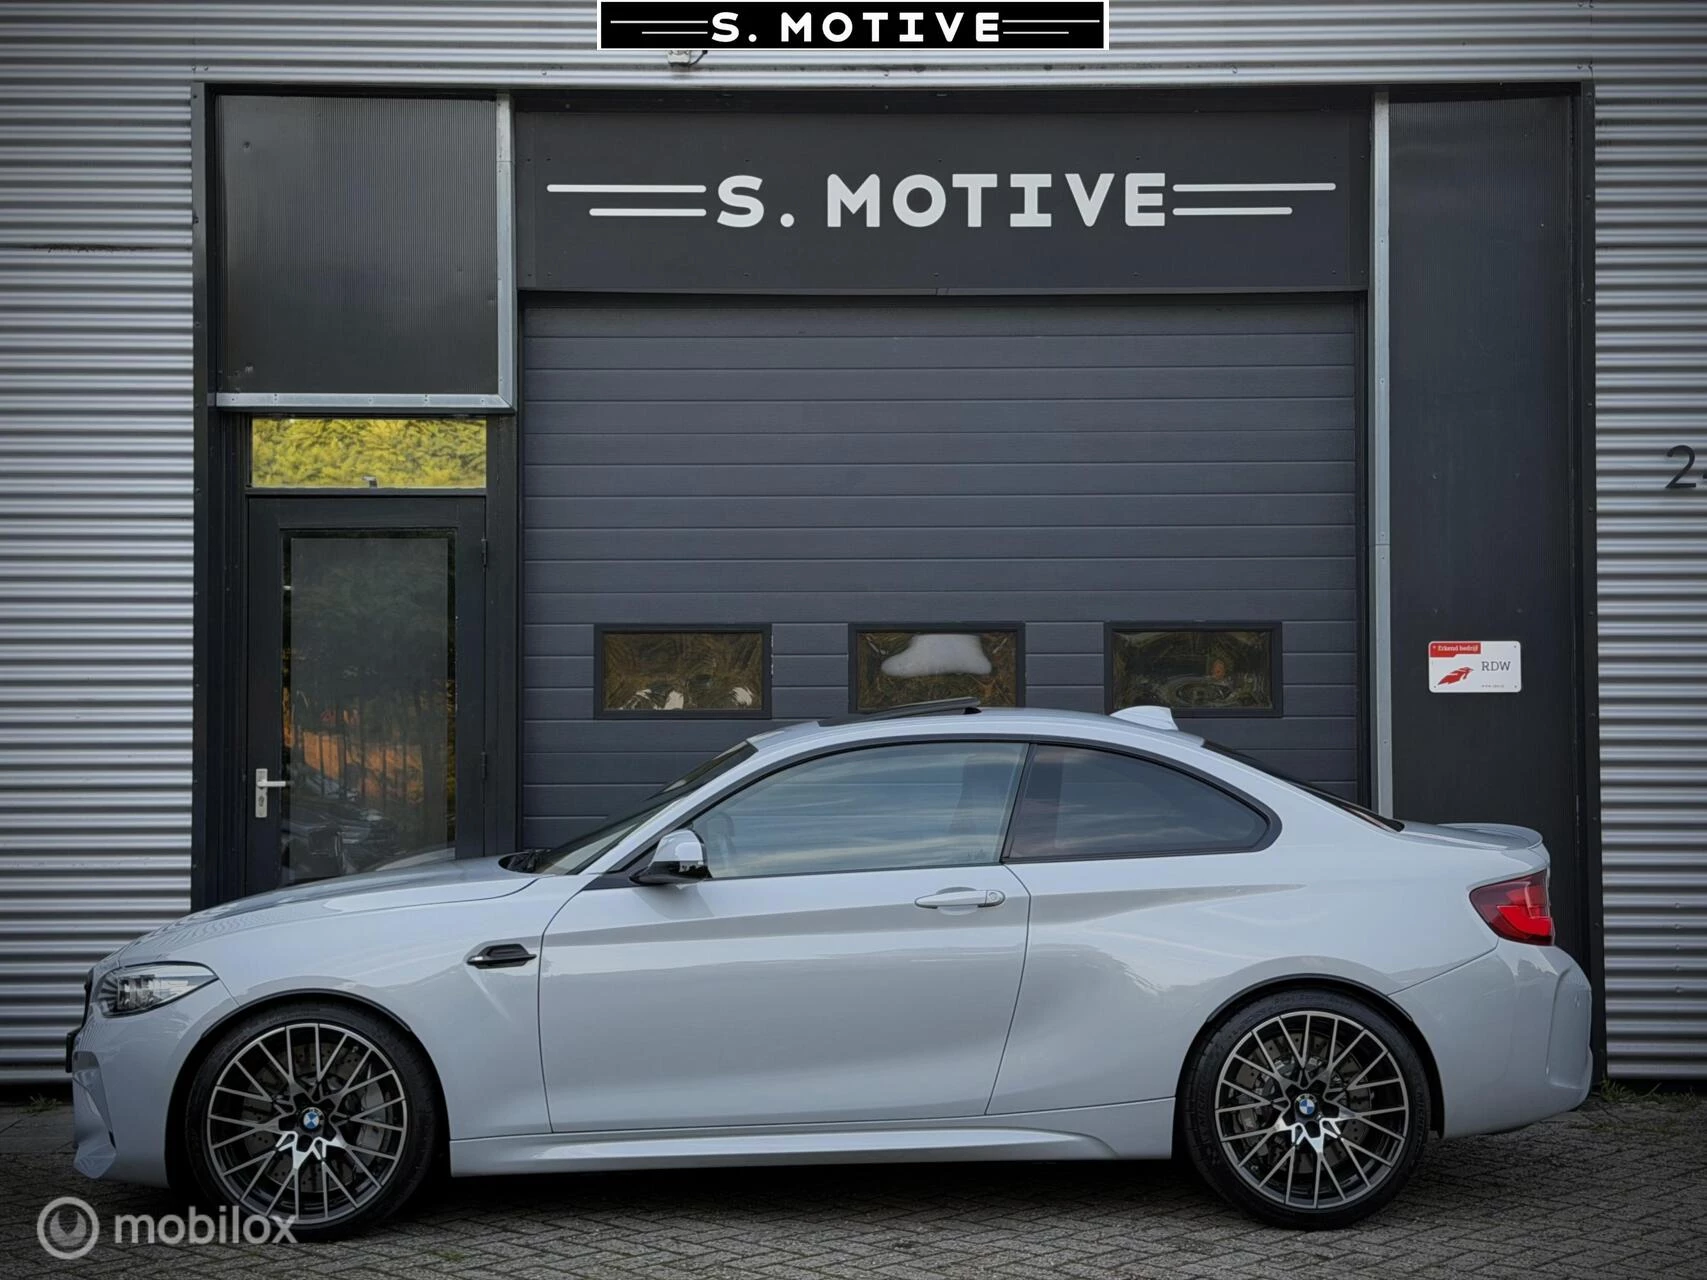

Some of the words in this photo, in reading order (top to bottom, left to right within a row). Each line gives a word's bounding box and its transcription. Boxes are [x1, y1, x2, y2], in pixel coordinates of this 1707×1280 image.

[716, 174, 795, 229] S.
[827, 172, 1167, 229] MOTIVE
[1481, 661, 1512, 672] RDW
